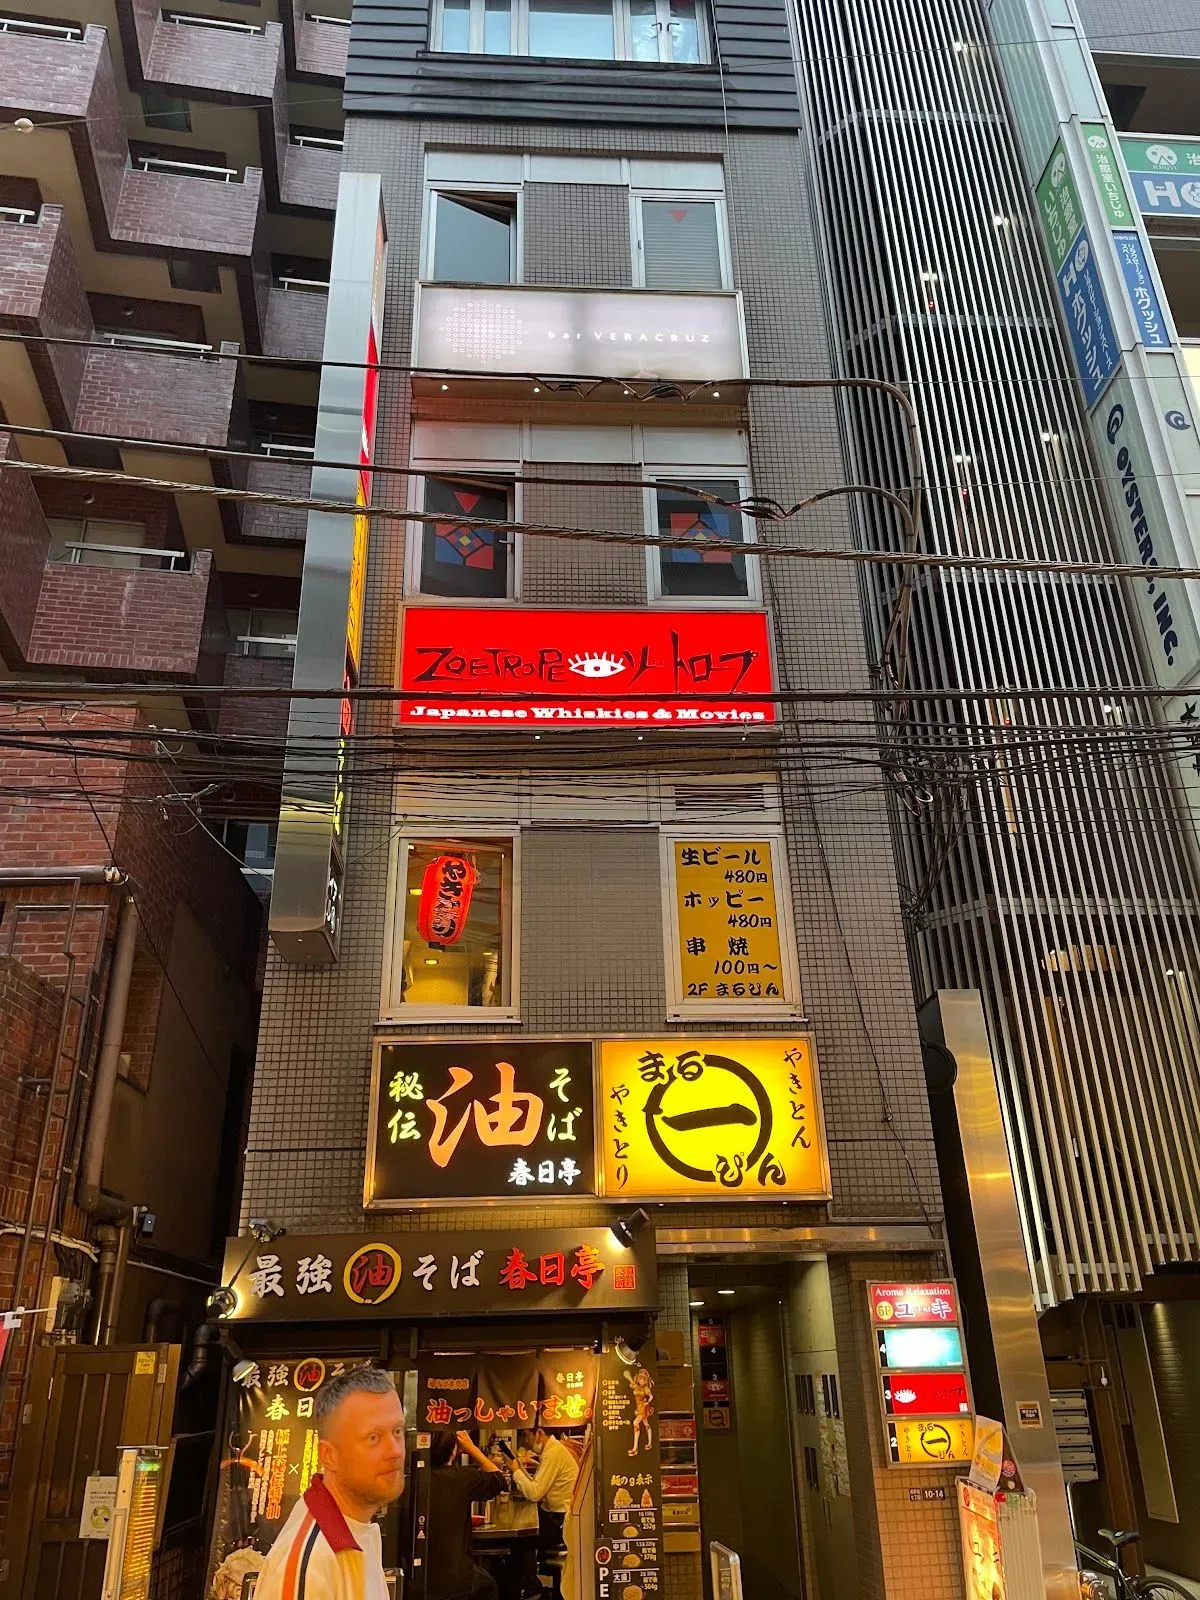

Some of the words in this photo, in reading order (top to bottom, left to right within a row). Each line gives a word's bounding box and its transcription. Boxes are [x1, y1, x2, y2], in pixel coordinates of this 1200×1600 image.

[548, 330, 582, 341] bar
[593, 331, 711, 344] VERACRUZ
[1153, 591, 1179, 667] INC.
[413, 647, 568, 683] ZOETROPE
[410, 705, 527, 719] Japanese
[533, 707, 648, 721] Whiskies
[653, 708, 673, 720] &
[676, 707, 765, 721] Movies
[681, 846, 761, 866] 生ビール
[724, 869, 768, 884] 480円
[684, 889, 765, 908] ホッピー
[727, 914, 772, 928] 480円
[687, 983, 709, 996] 2F
[637, 1050, 704, 1083] まる
[387, 1070, 424, 1145] 秘伝
[547, 1067, 584, 1142] そば
[784, 1047, 811, 1149] やきとん
[425, 1061, 545, 1169] 油
[610, 1083, 630, 1190] やきとり
[507, 1158, 582, 1186] 春日亭
[499, 1243, 605, 1291] 春日亭
[875, 1287, 904, 1297] Aroma
[905, 1285, 951, 1297] Relaxation
[880, 1343, 887, 1353] 4
[884, 1389, 892, 1400] 3
[890, 1436, 898, 1448] 2
[924, 1489, 944, 1499] 10-14
